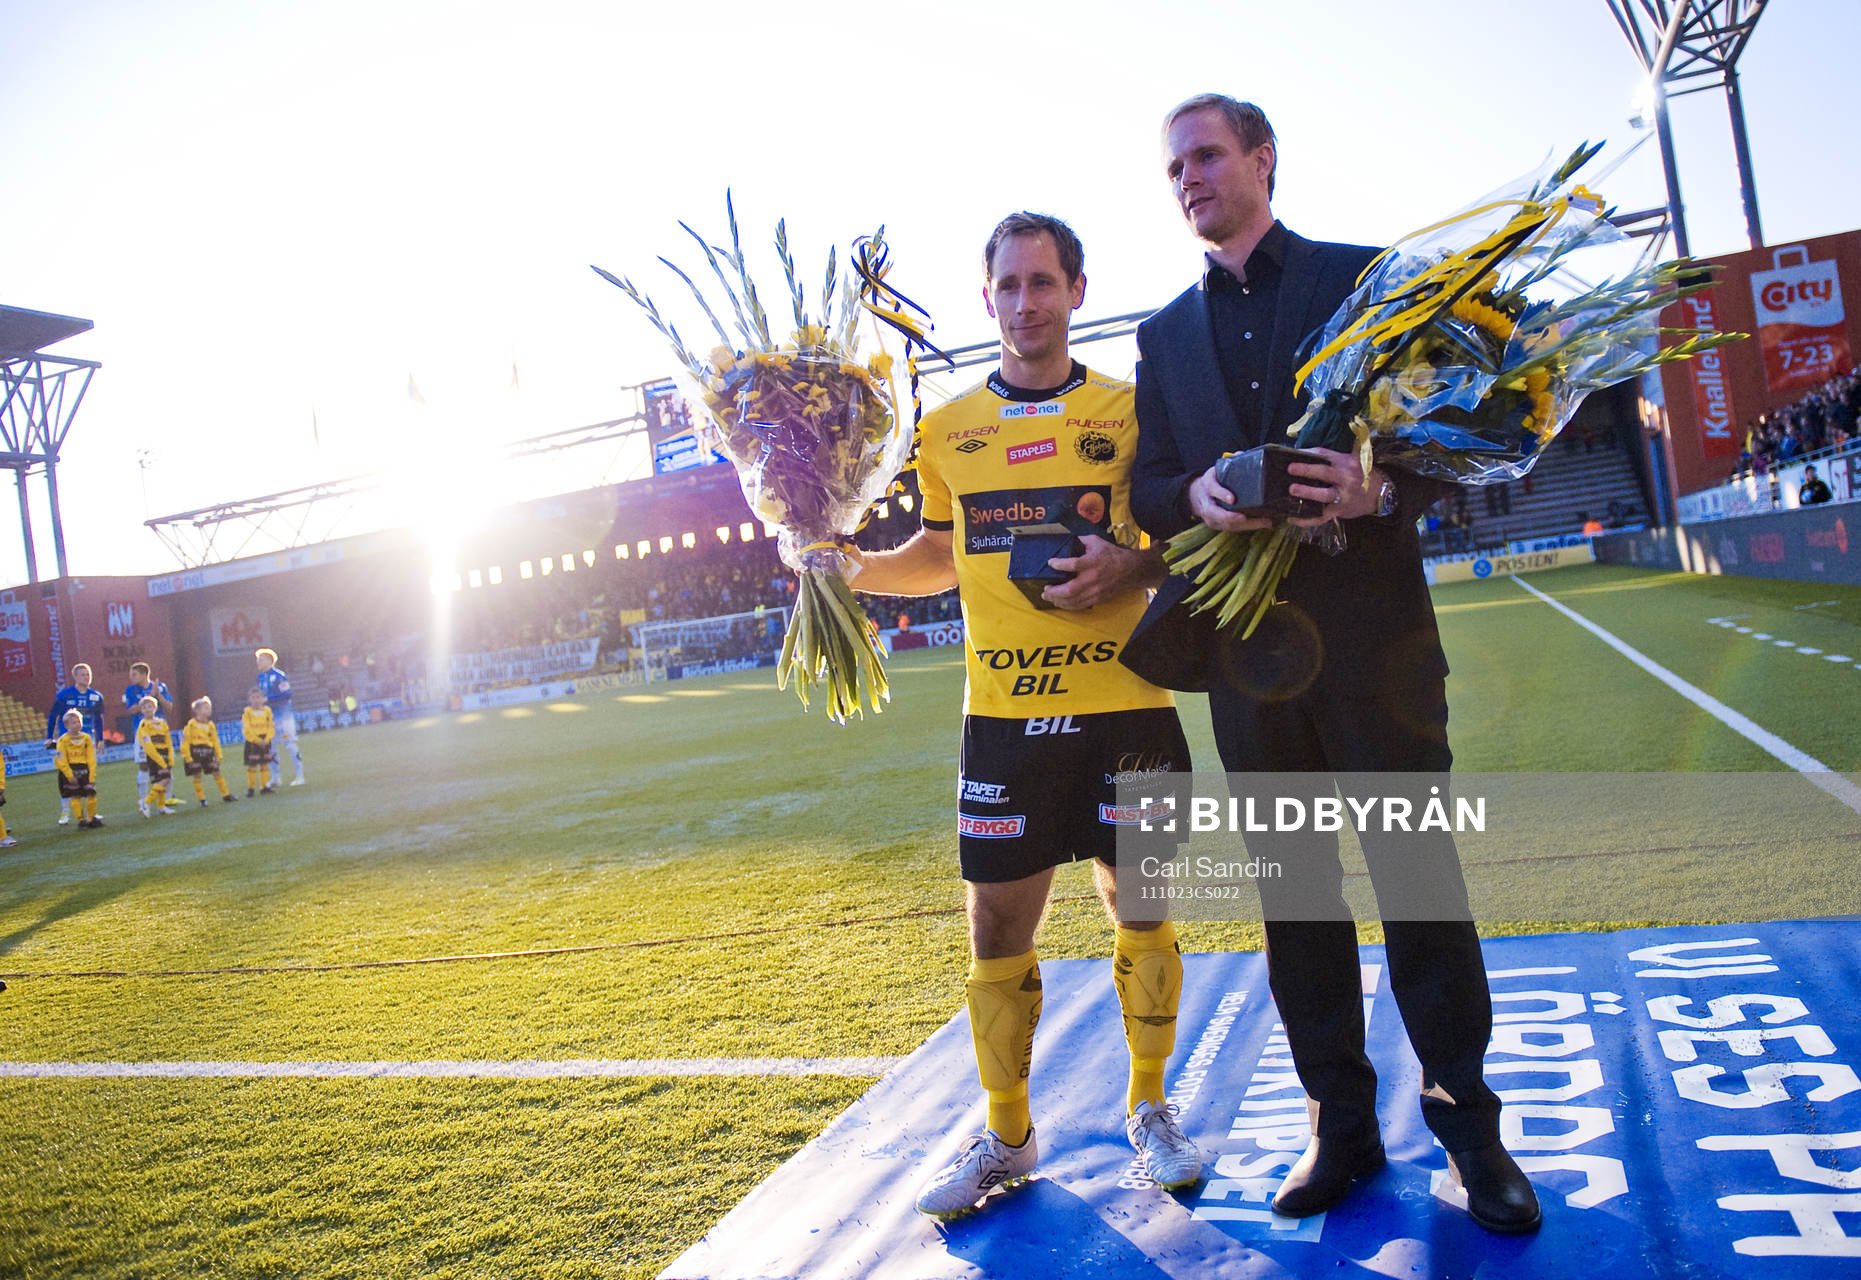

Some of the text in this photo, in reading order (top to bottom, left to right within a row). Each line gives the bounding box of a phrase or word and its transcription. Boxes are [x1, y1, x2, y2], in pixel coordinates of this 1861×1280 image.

[1761, 279, 1832, 312] City
[1779, 343, 1834, 370] 7-23
[947, 425, 1000, 442] PULSEN
[1065, 418, 1125, 429] PULSEN
[1009, 442, 1054, 460] STAPLES
[969, 502, 1046, 525] Swedba
[924, 628, 962, 648] TOO
[976, 641, 1118, 670] TOVEKS
[1011, 673, 1069, 696] BIL
[1024, 715, 1081, 736] BIL
[966, 780, 1006, 797] TAPET
[1214, 989, 1249, 1014] HELA
[1184, 1016, 1237, 1069] SVERIGES
[1646, 993, 1861, 1109] SES
